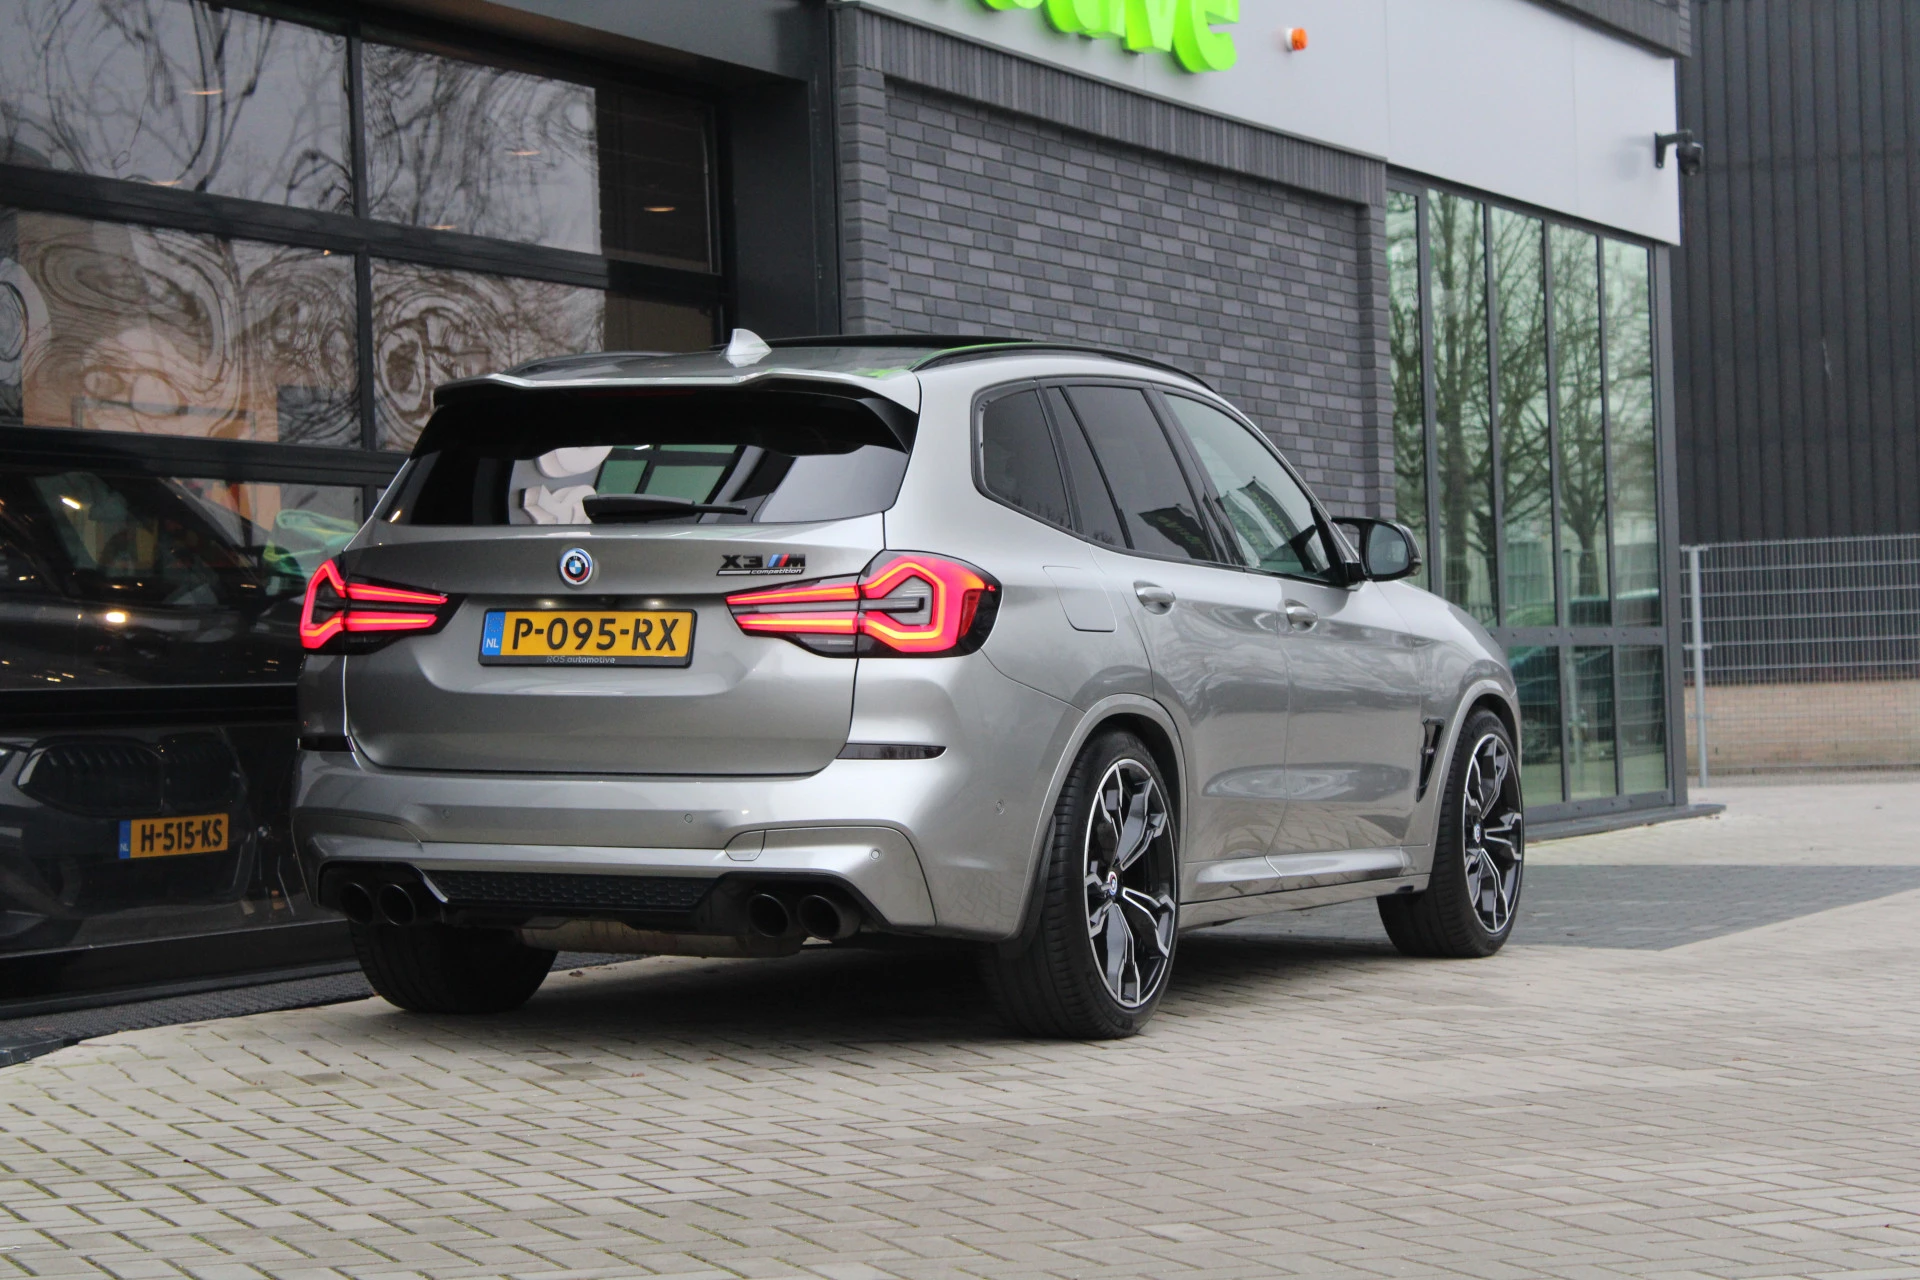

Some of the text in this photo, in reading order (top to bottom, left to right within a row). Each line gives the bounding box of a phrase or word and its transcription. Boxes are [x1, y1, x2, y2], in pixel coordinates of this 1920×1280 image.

[720, 554, 763, 568] X3
[512, 617, 679, 650] P-095-RX
[485, 637, 499, 648] NL
[567, 655, 616, 663] automotive
[141, 818, 223, 852] H-515-KS
